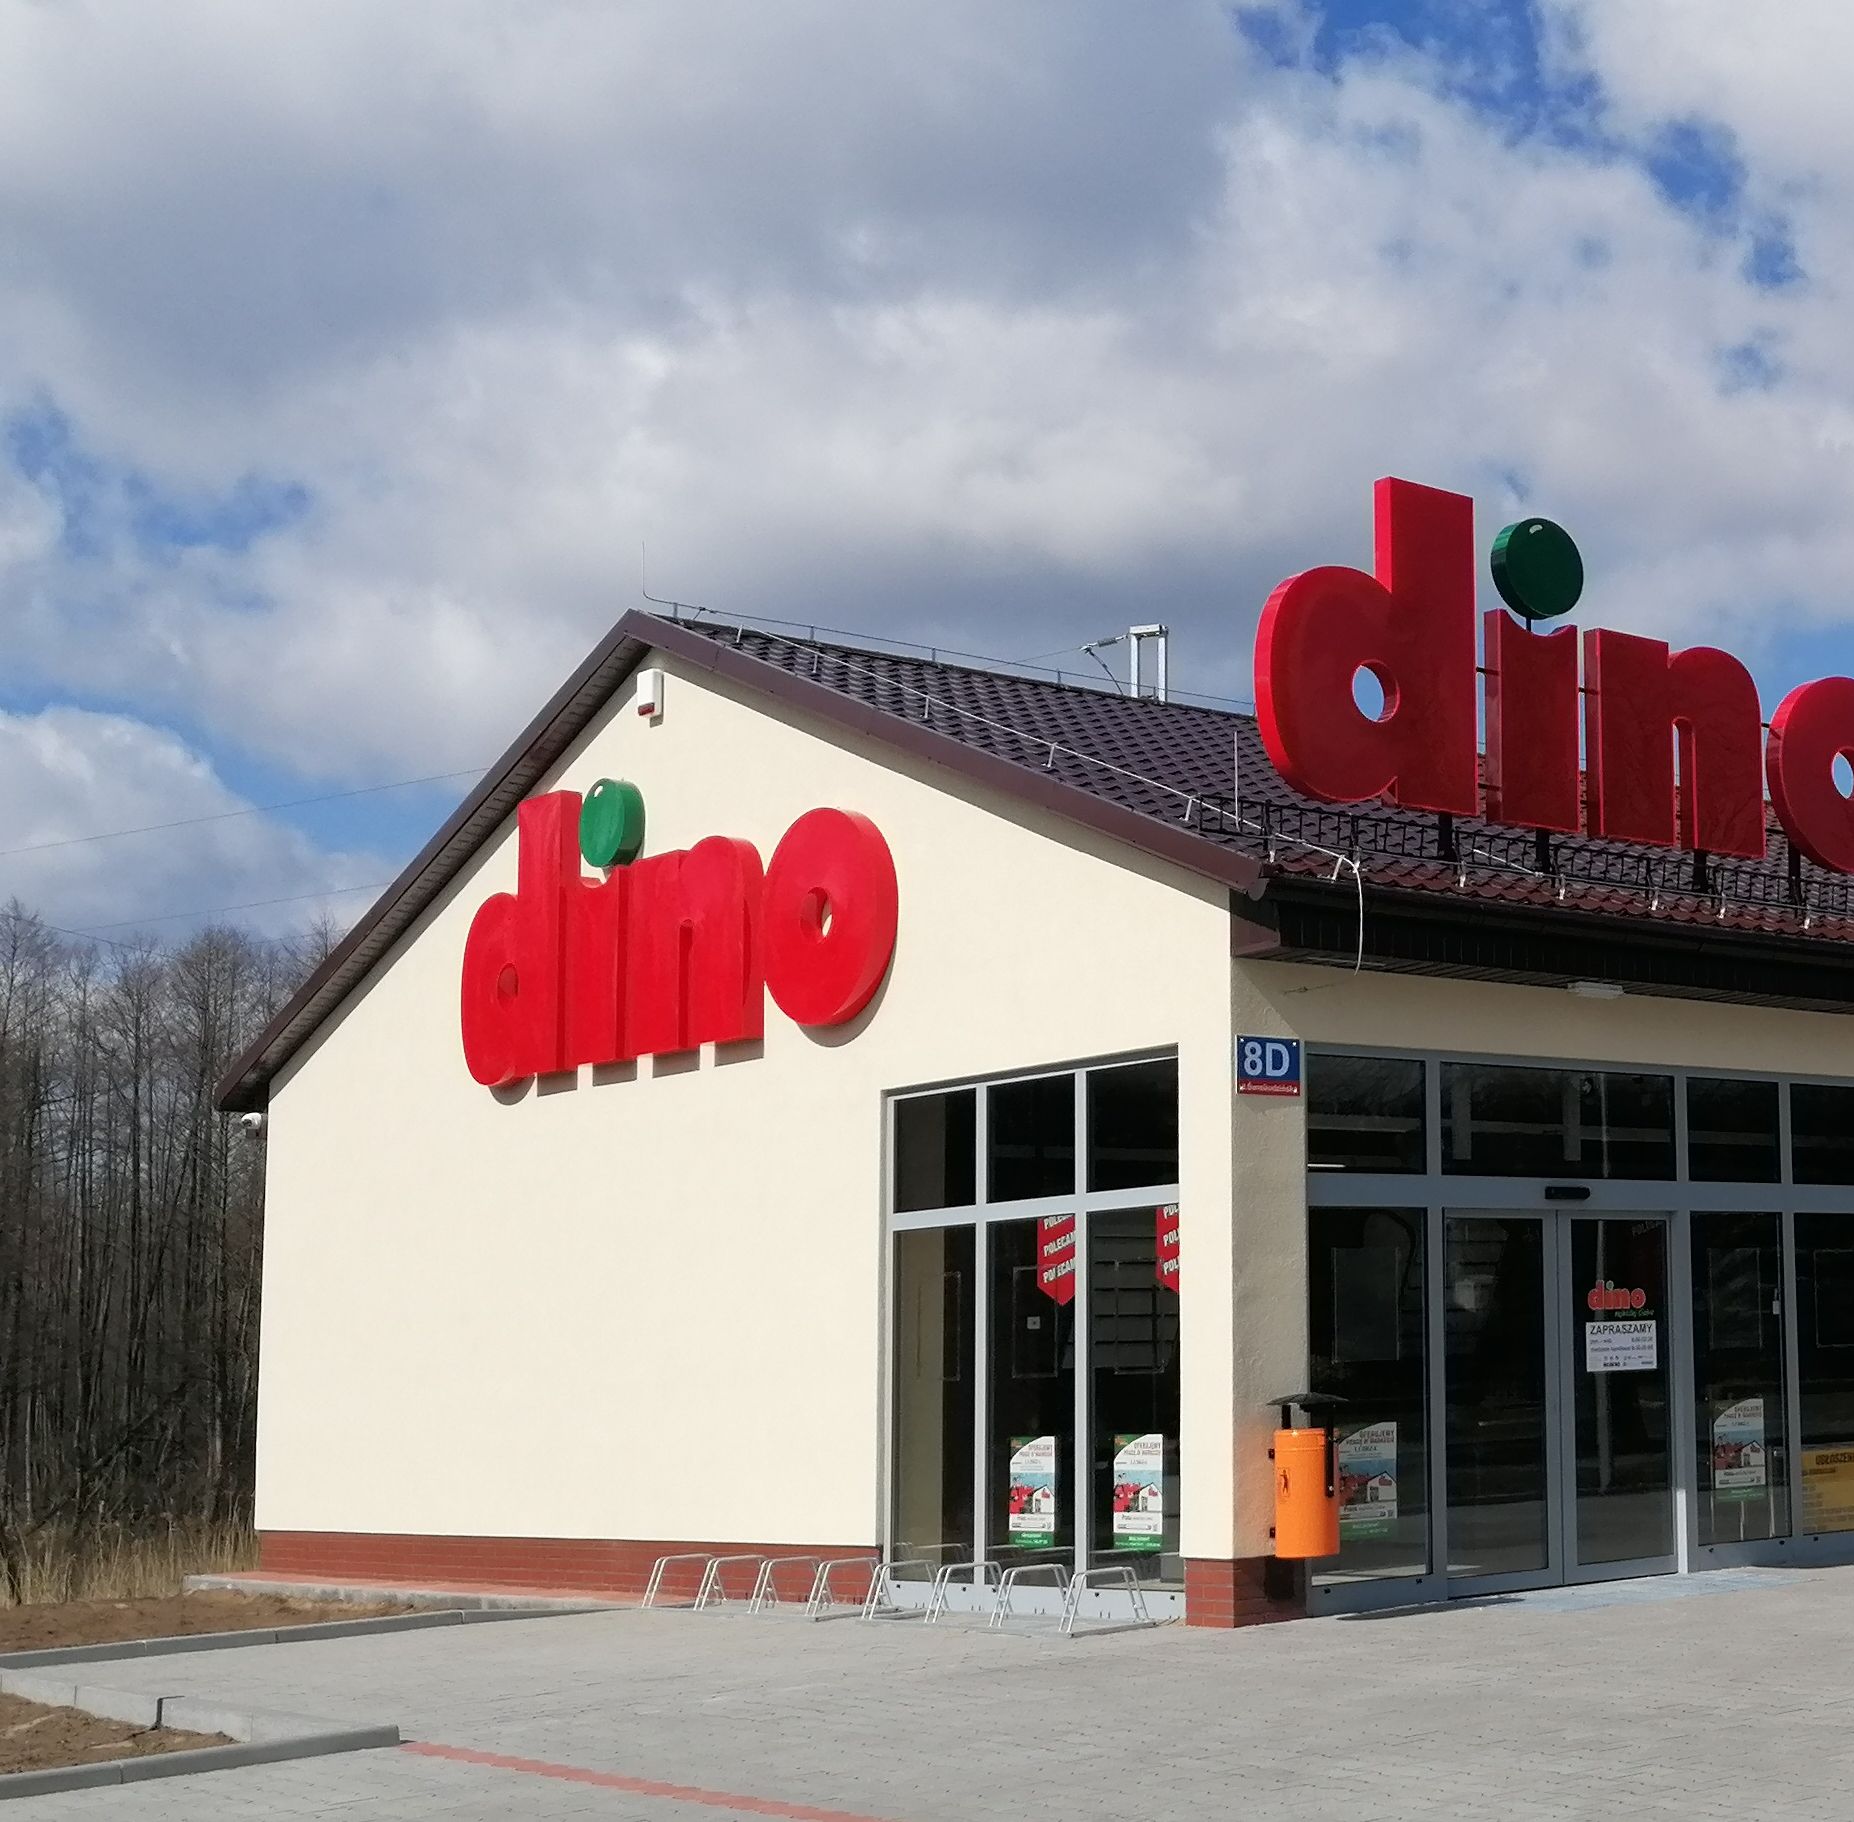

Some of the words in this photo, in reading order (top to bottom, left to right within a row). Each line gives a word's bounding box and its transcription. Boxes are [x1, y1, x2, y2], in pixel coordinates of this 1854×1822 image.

[461, 778, 899, 1086] dino
[1244, 1041, 1290, 1077] 8D
[1587, 1280, 1646, 1310] dino
[1590, 1324, 1653, 1335] ZAPRASZAMY
